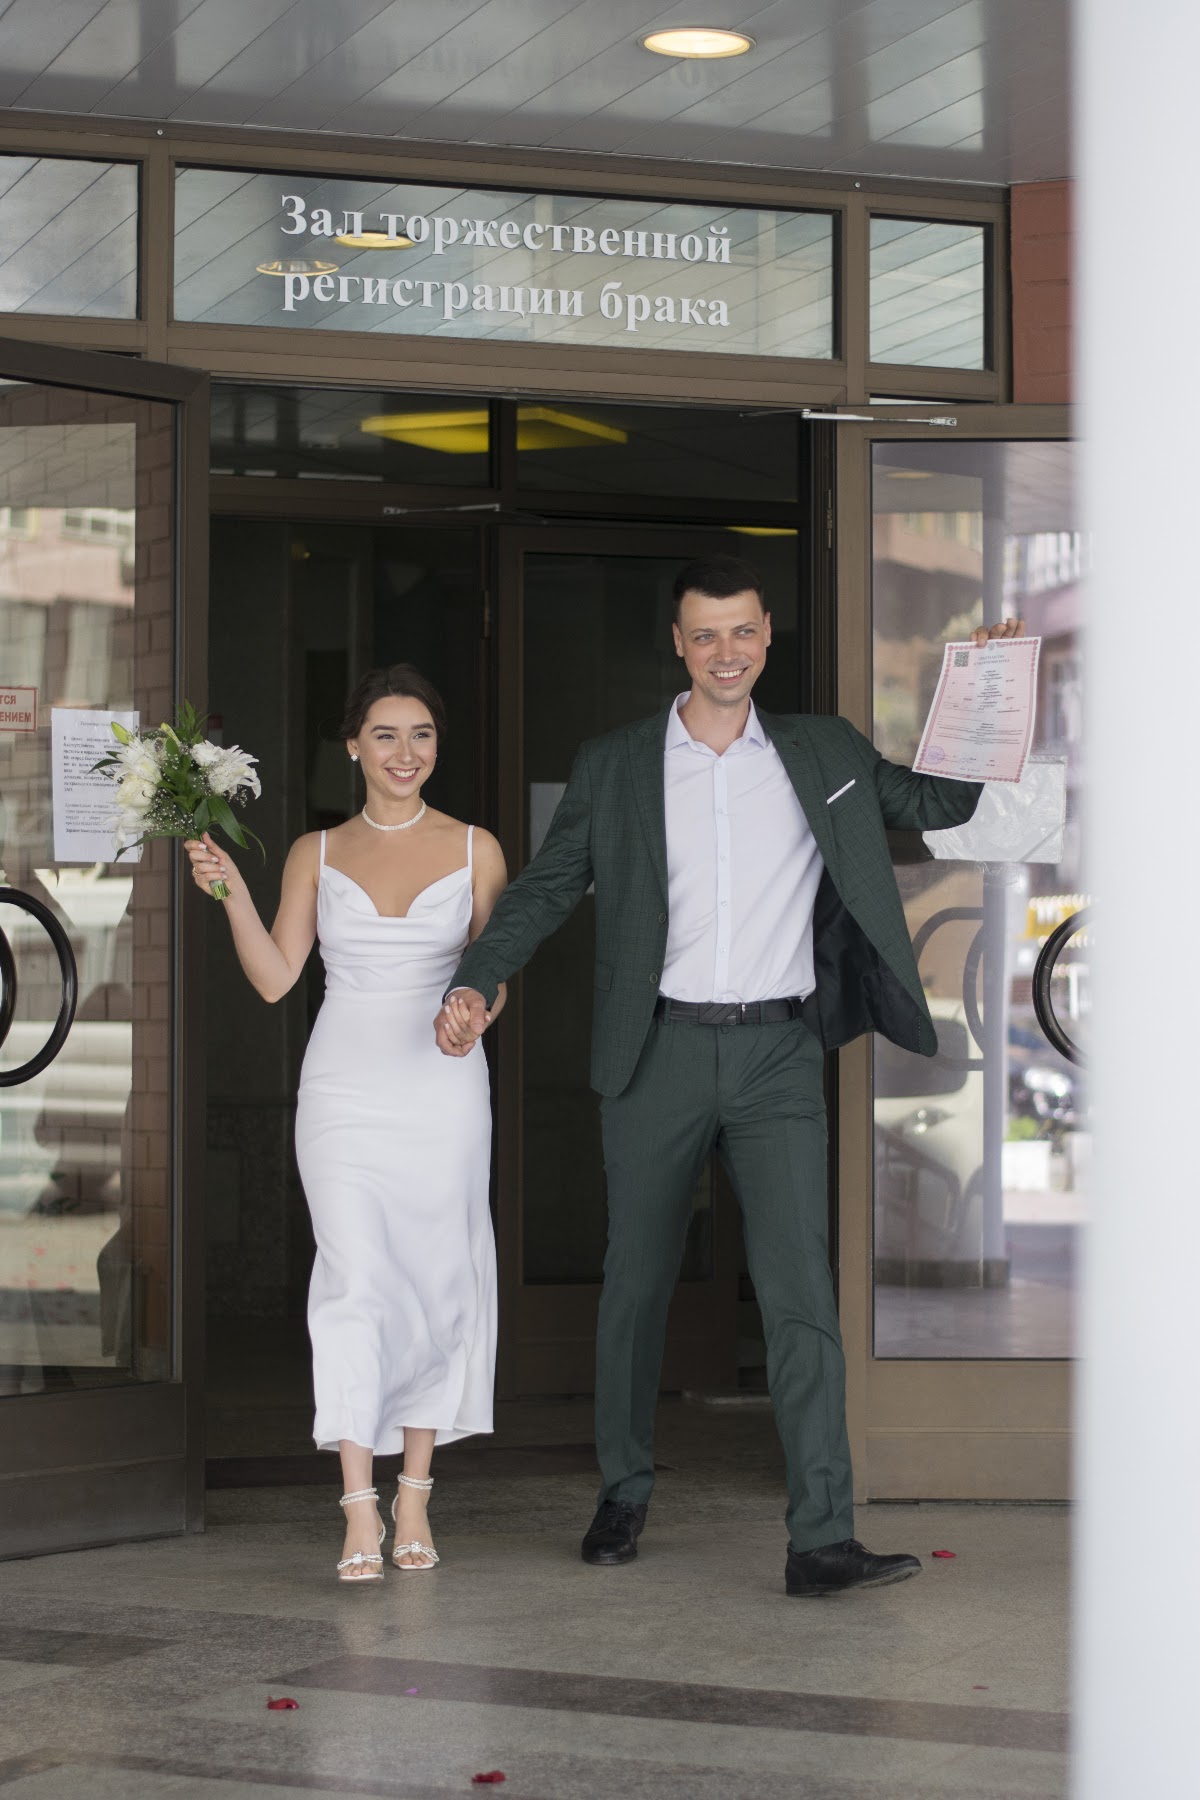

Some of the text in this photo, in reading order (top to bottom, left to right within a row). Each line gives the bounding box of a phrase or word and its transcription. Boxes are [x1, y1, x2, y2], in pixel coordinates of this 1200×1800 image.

[280, 195, 732, 264] Зал торжественной
[281, 272, 730, 332] регистрации брака
